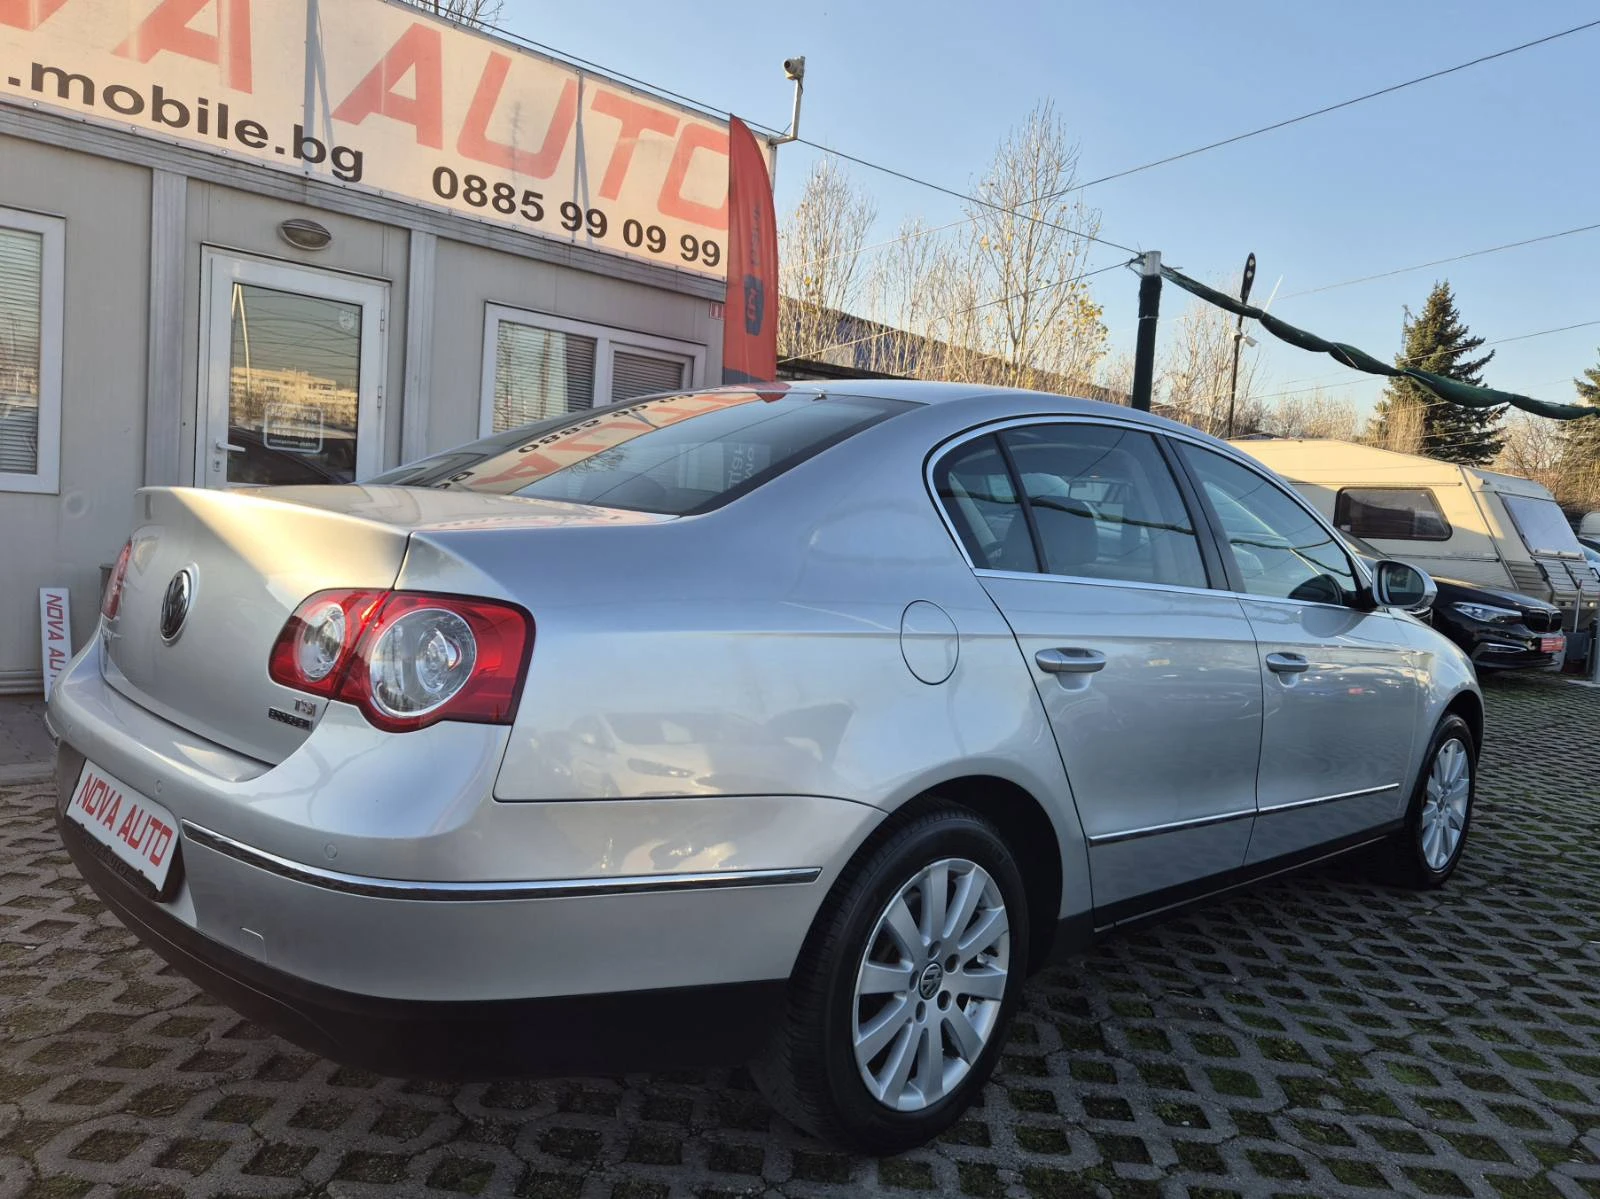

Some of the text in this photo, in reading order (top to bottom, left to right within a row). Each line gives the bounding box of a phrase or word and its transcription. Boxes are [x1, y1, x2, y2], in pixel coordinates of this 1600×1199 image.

[332, 22, 730, 230] AUTO
[432, 165, 546, 223] 0885
[560, 200, 608, 239] 99
[623, 218, 668, 254] 09
[680, 233, 722, 268] 99
[46, 593, 66, 686] NOVA AU
[75, 772, 174, 867] NOVA AUTO
